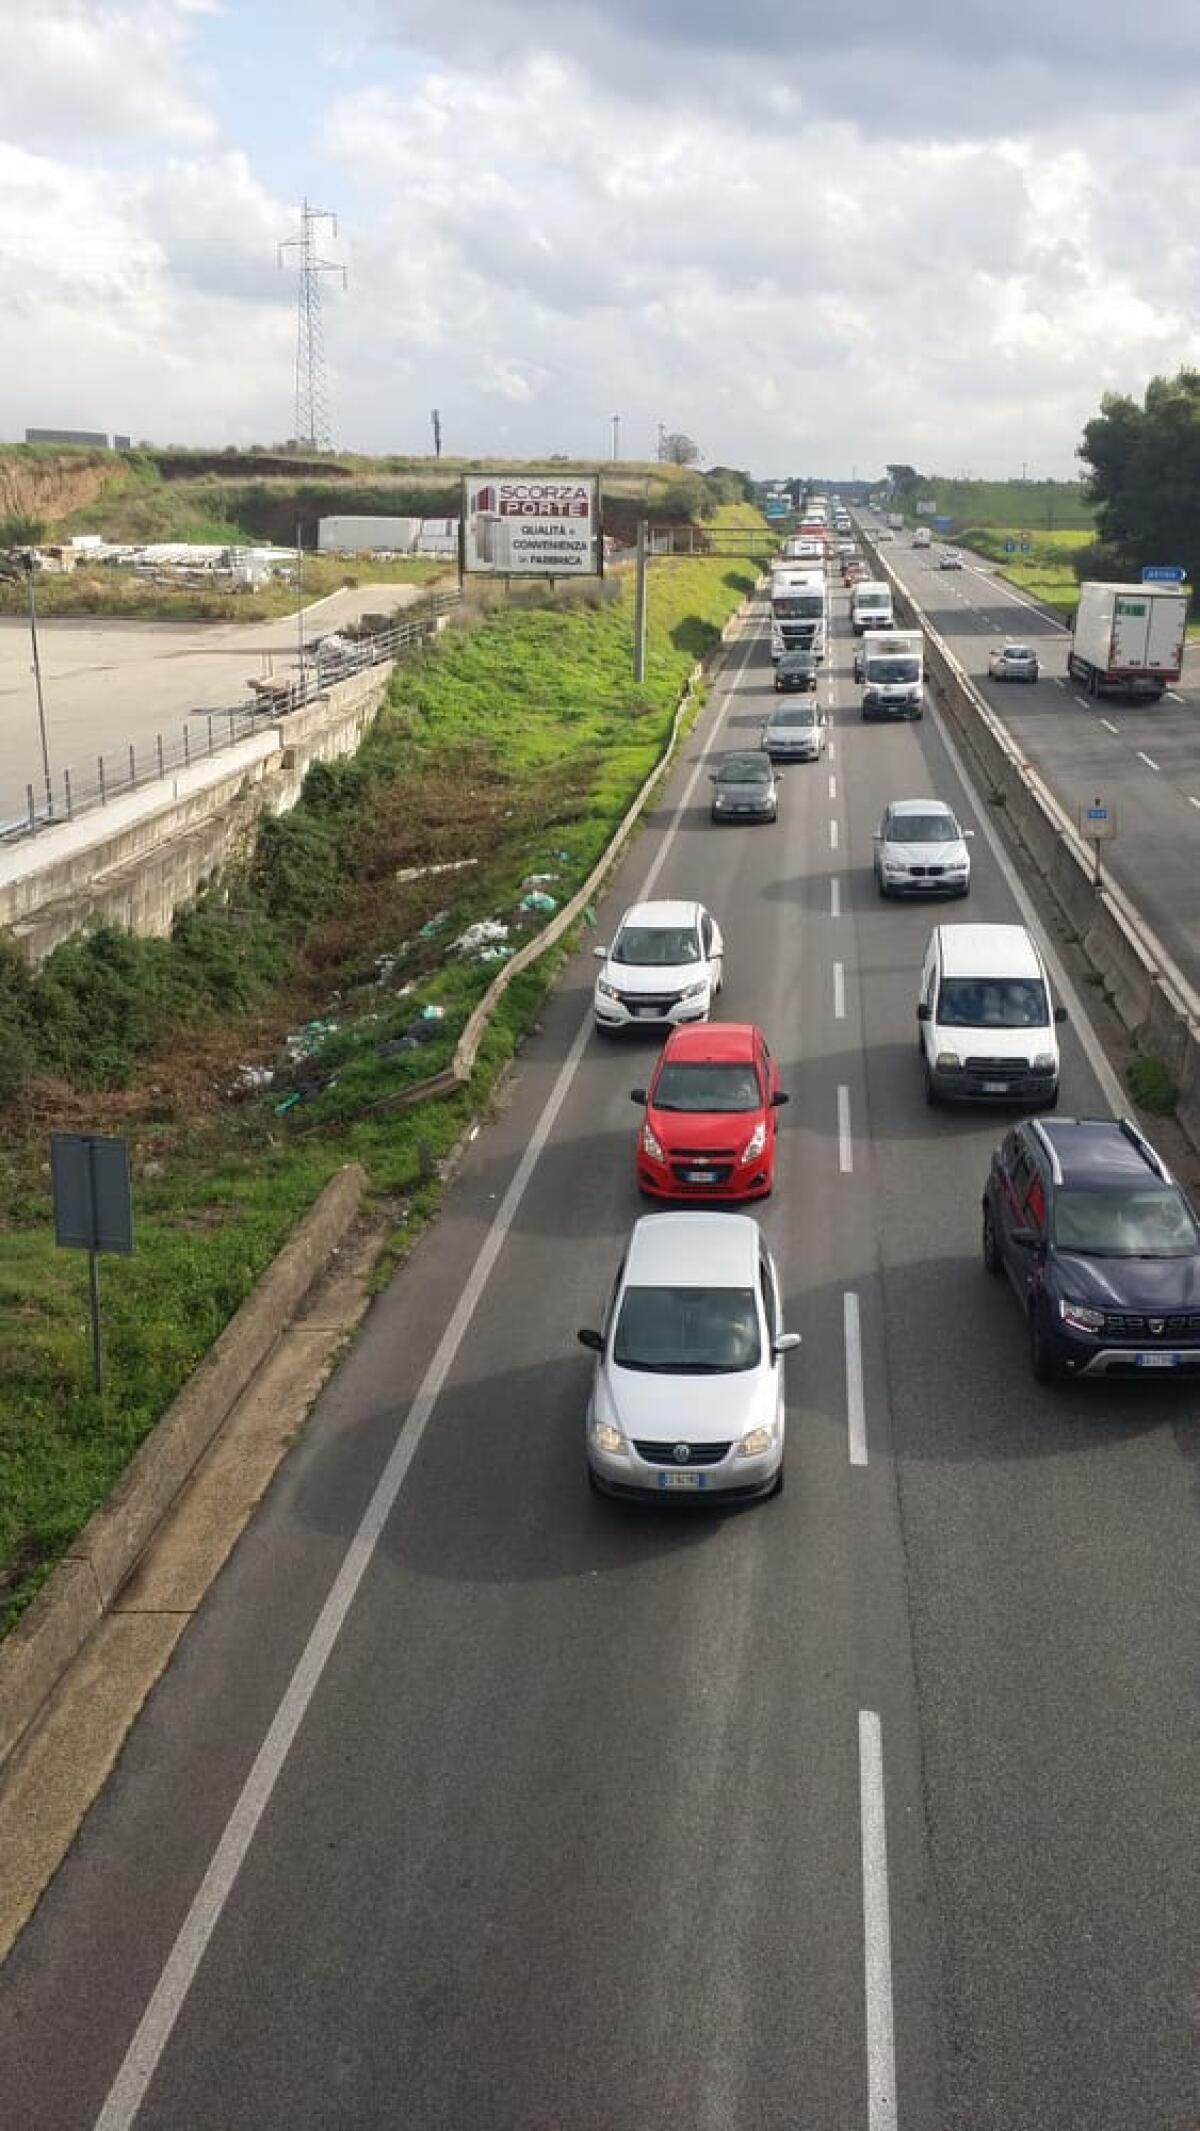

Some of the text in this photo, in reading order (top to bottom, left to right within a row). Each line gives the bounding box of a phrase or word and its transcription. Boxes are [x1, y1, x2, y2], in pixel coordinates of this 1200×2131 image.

[500, 485, 587, 499] SCORZA
[506, 502, 583, 517] PORTE
[512, 539, 587, 550] CONVENIENZA
